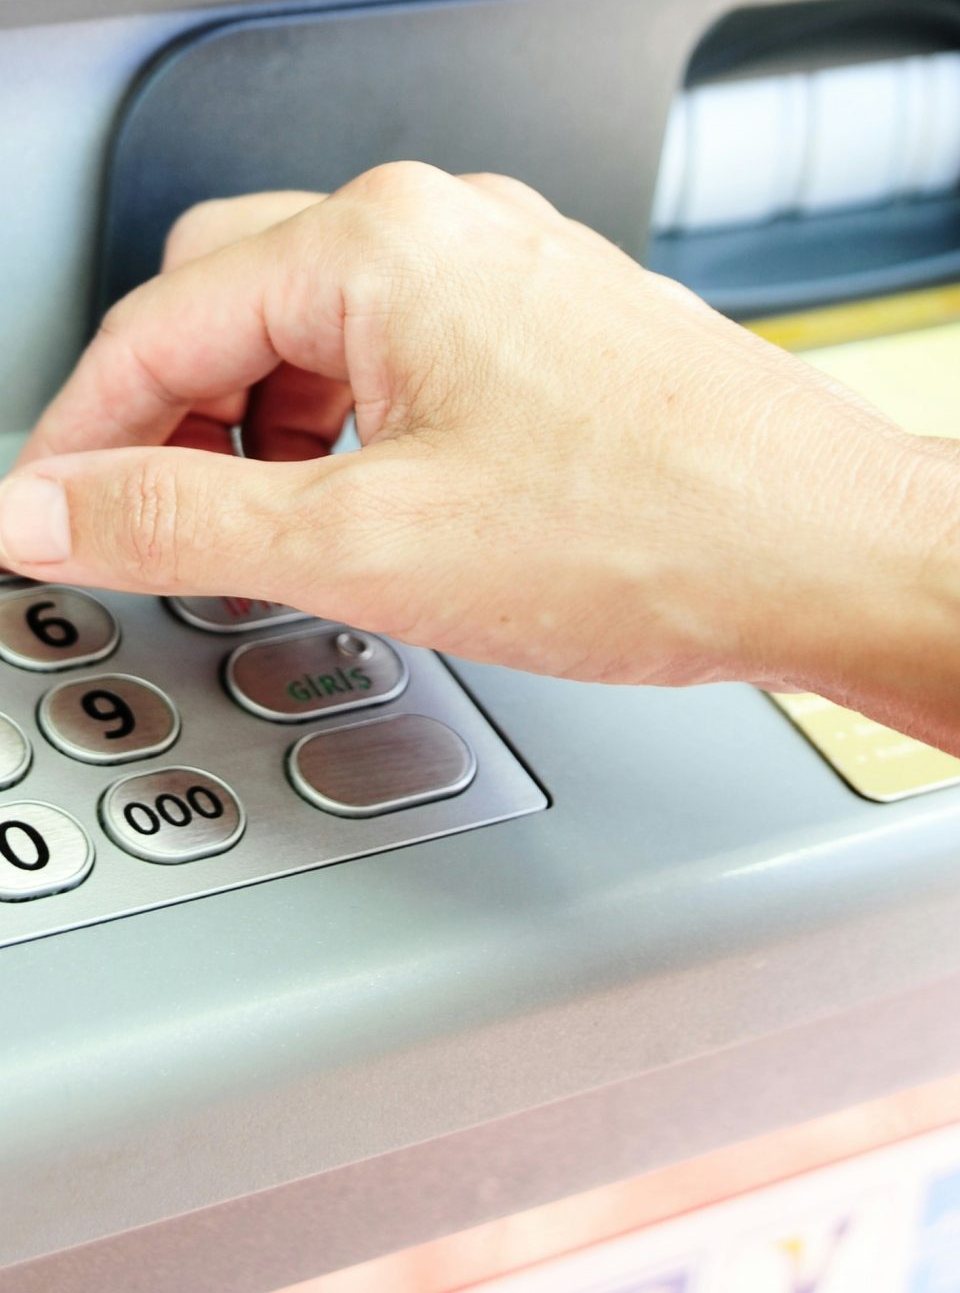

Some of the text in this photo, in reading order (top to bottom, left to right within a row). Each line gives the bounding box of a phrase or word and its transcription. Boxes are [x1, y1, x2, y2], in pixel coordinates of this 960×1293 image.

[24, 601, 79, 650] 6
[80, 689, 137, 740] 9
[123, 784, 224, 836] 000
